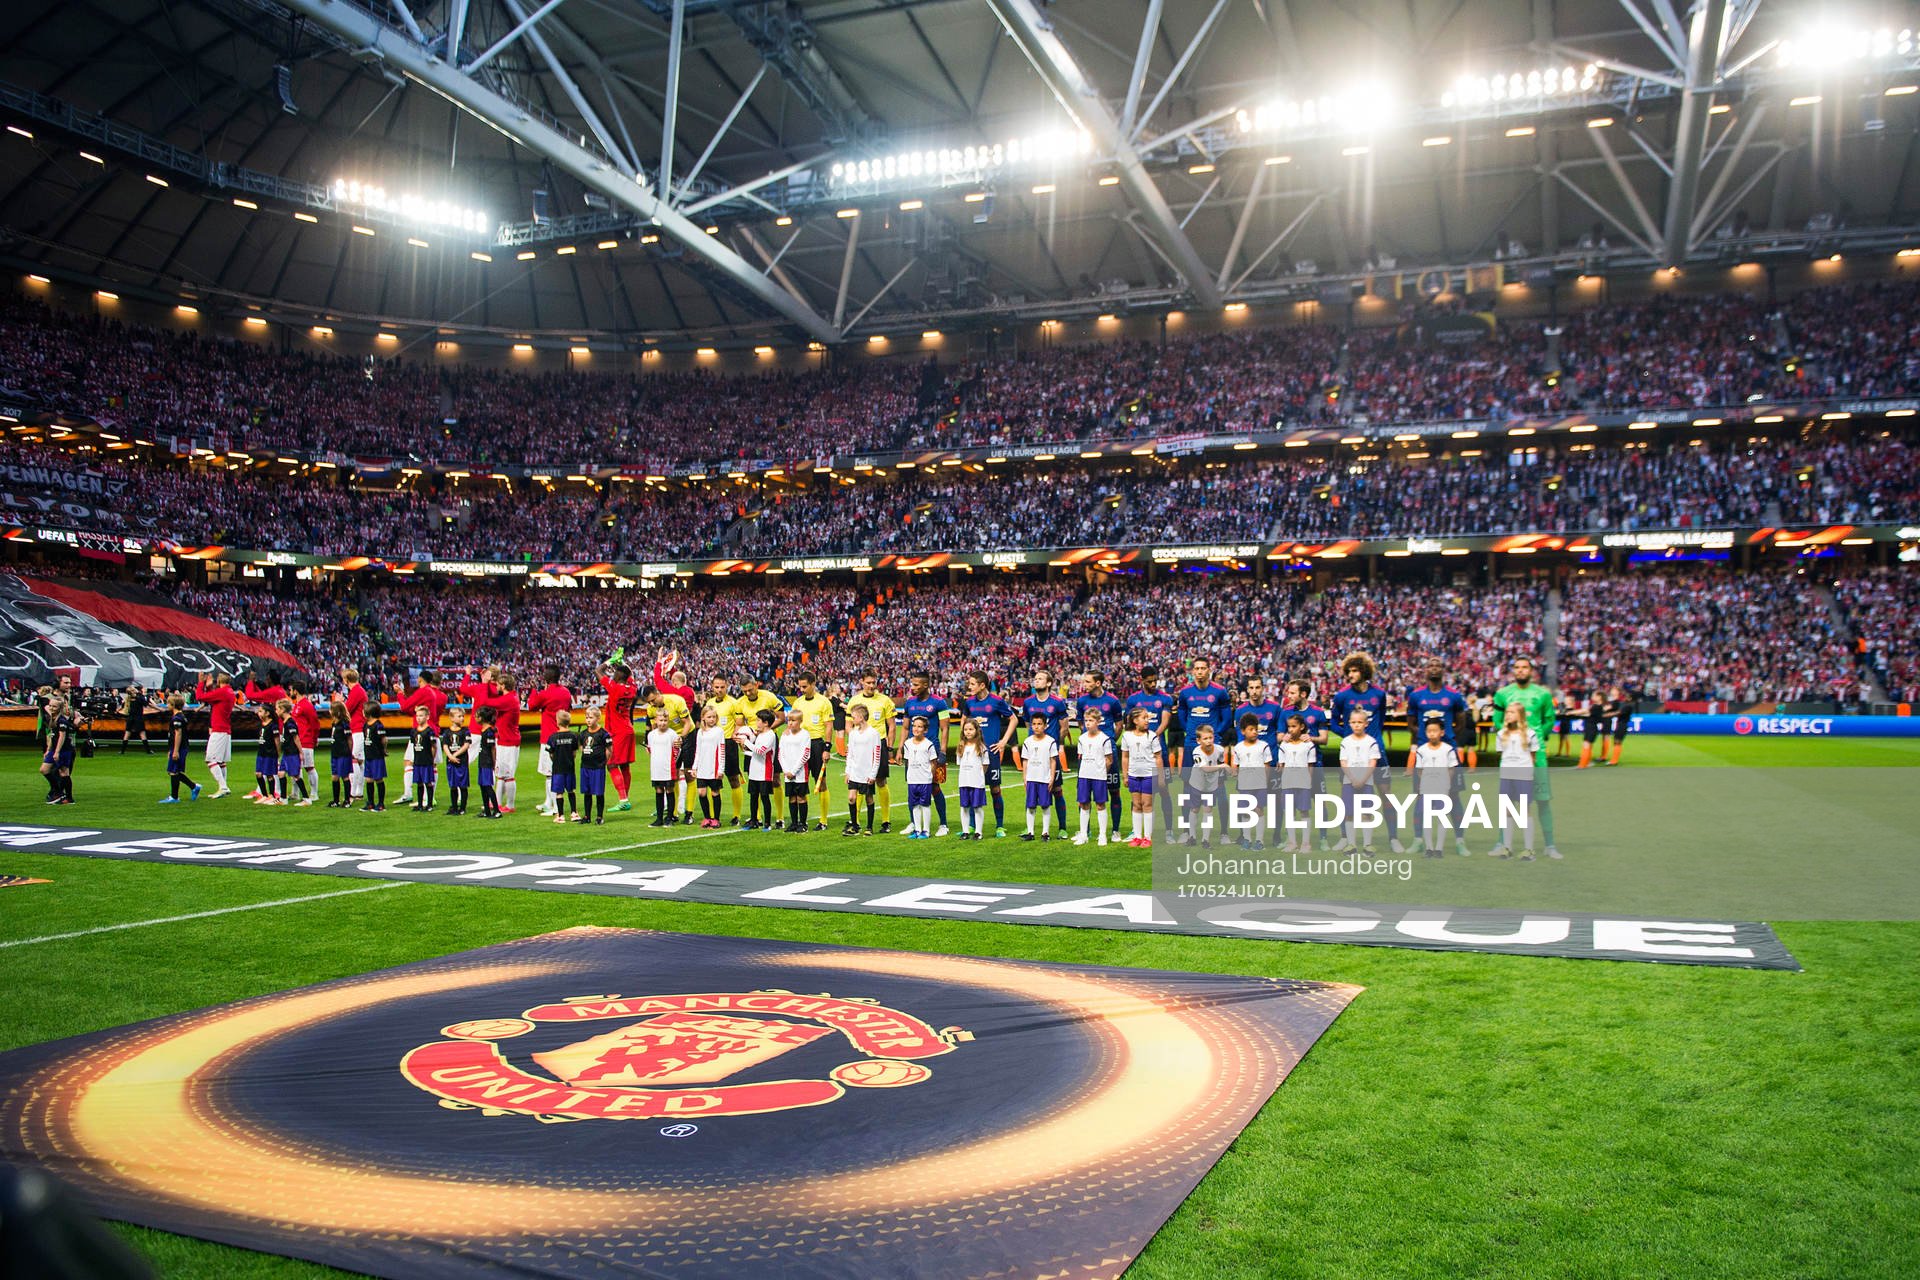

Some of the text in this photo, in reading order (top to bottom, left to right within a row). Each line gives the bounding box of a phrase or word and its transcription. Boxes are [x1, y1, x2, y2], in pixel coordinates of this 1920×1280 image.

[3, 407, 22, 416] 2017
[991, 445, 1080, 457] UEFA EUROPA LEAGUE
[533, 467, 561, 477] AMSTEL
[38, 529, 66, 542] UEFA
[993, 552, 1026, 563] AMSTEL
[1152, 545, 1259, 558] STOCKHOLM FINAL 2017
[430, 562, 528, 574] STOCKHOLM FINAL 2017
[781, 558, 869, 569] UEFA EUROPA LEAGUE
[1758, 718, 1832, 734] RESPECT
[1107, 773, 1118, 784] 36
[62, 836, 709, 893] EUROPA
[739, 876, 1757, 959] LEAGUE
[571, 997, 926, 1050] MANCHESTER
[431, 1067, 723, 1113] UNITED
